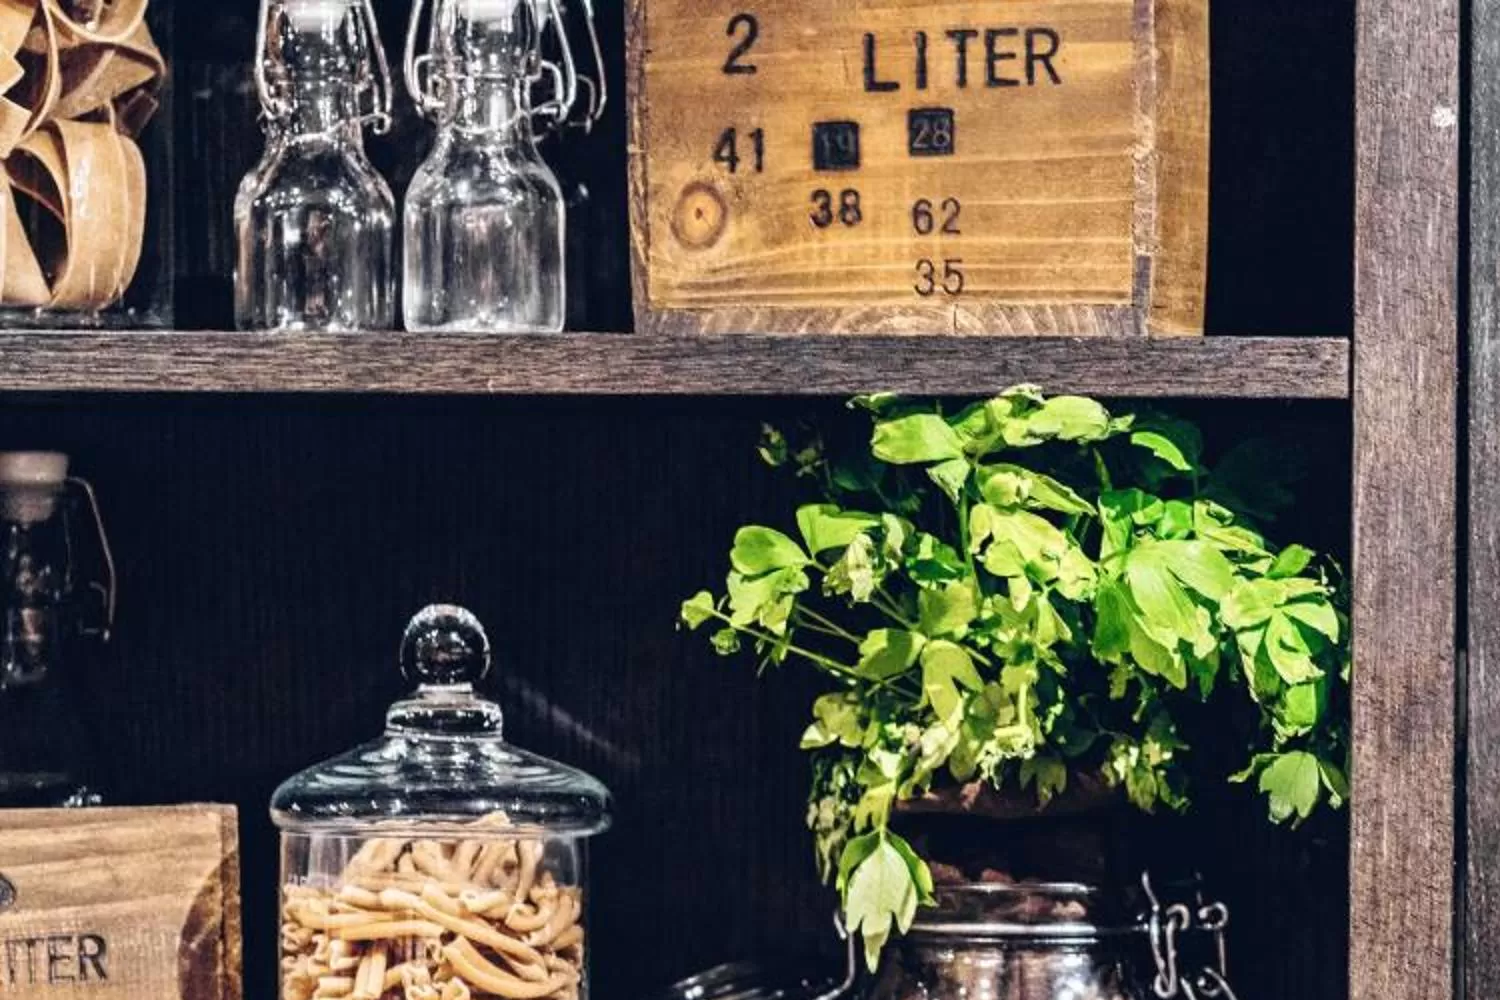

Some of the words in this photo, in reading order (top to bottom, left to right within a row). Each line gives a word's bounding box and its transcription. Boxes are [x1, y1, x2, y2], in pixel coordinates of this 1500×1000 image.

[722, 13, 758, 75] 2
[862, 26, 1062, 92] LITER
[712, 127, 766, 173] 41
[911, 114, 953, 151] 28
[810, 188, 862, 228] 38
[912, 197, 961, 235] 62
[914, 258, 965, 296] 35
[0, 933, 108, 985] ITER
